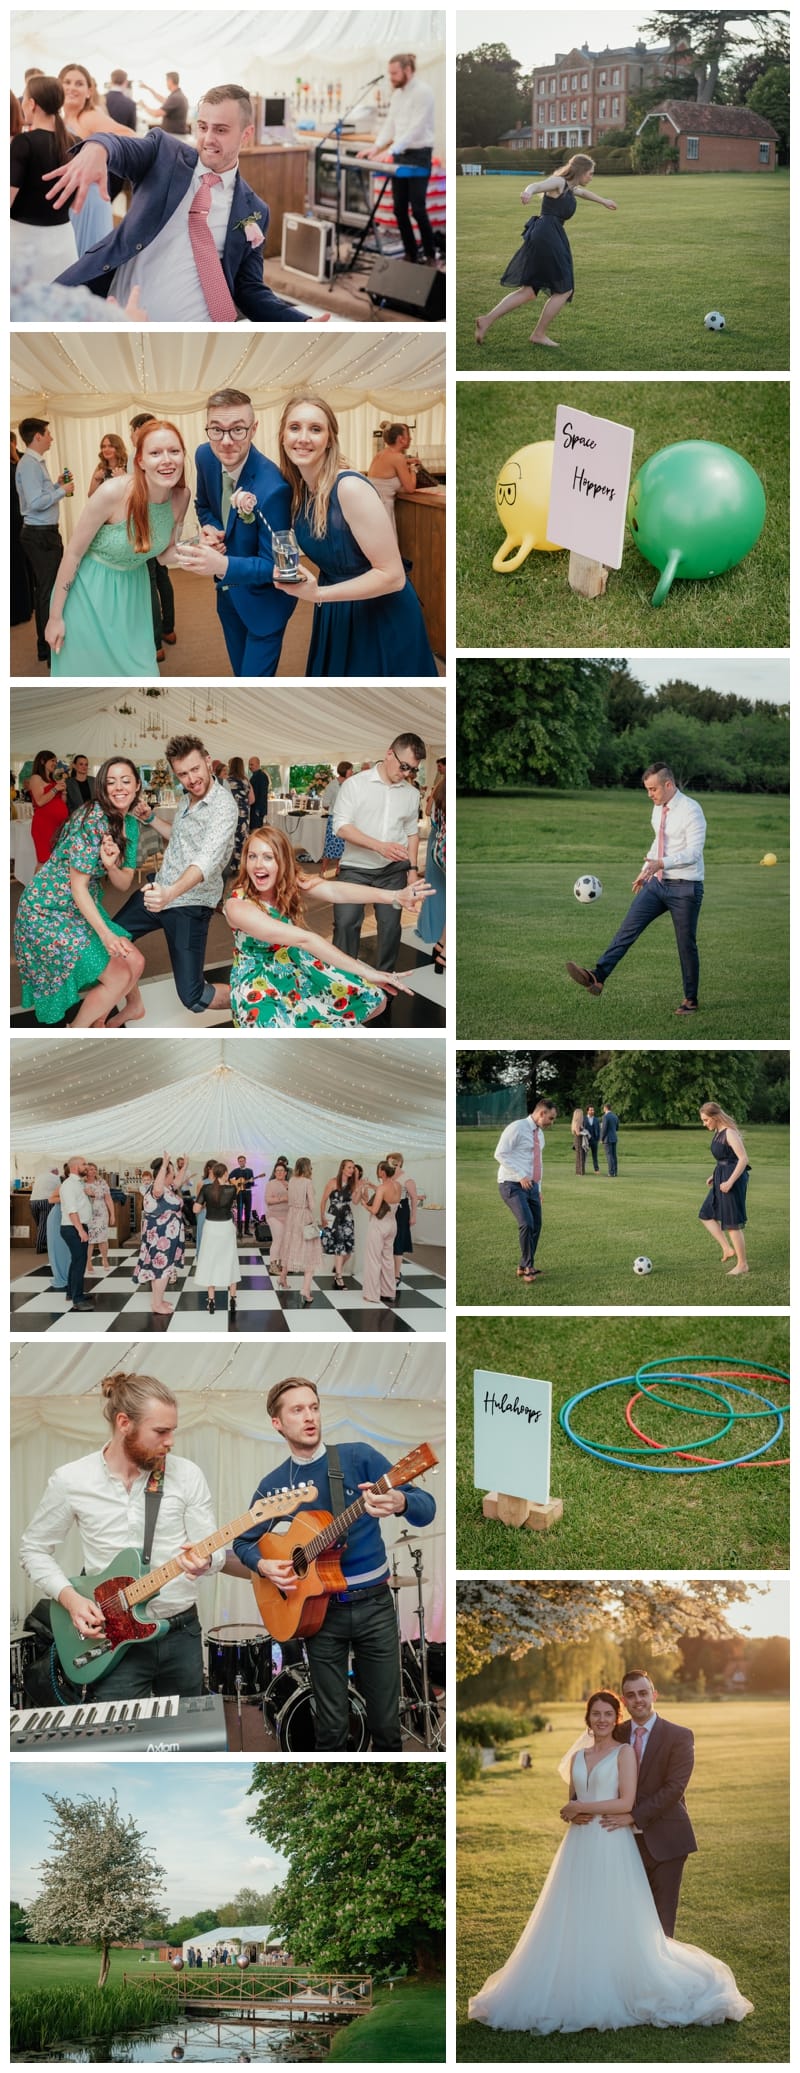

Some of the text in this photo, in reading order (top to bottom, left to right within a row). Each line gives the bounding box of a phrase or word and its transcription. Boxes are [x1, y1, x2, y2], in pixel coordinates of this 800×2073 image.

[562, 422, 597, 450] Space
[572, 466, 616, 501] Hoppers
[483, 1391, 543, 1424] Hulahoops
